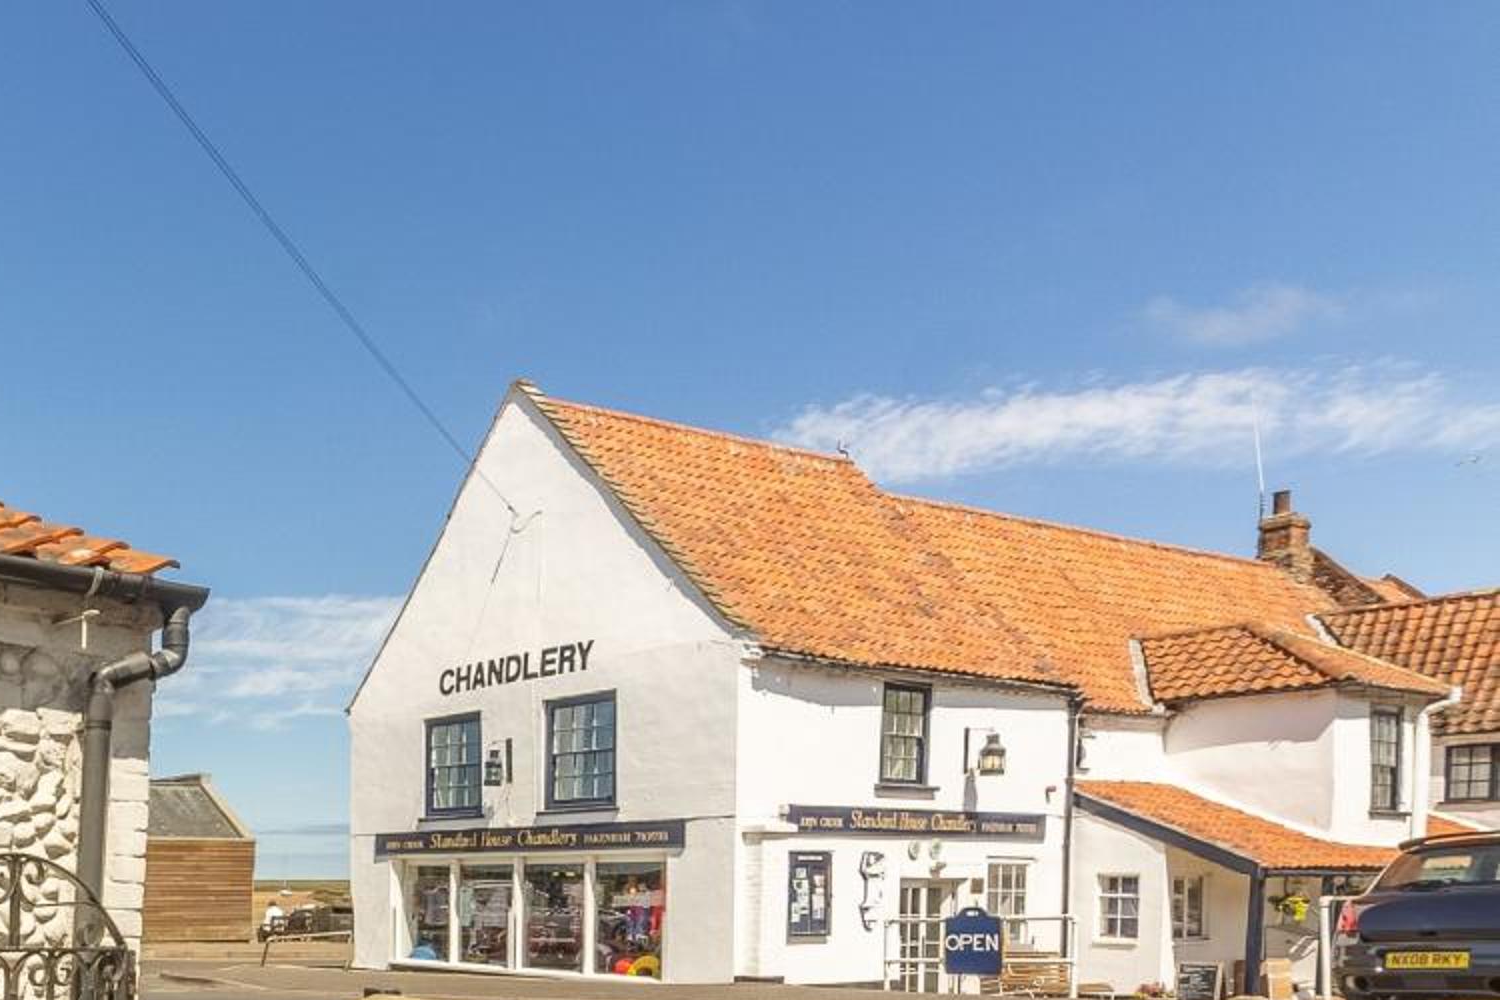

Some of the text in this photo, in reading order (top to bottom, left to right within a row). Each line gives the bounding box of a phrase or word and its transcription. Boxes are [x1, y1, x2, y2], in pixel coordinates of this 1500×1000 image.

[439, 639, 595, 696] CHANDLERY
[850, 809, 898, 829] Standard
[429, 832, 478, 849] Standard
[481, 830, 513, 847] House
[517, 829, 577, 847] Chandlery
[945, 933, 999, 952] OPEN
